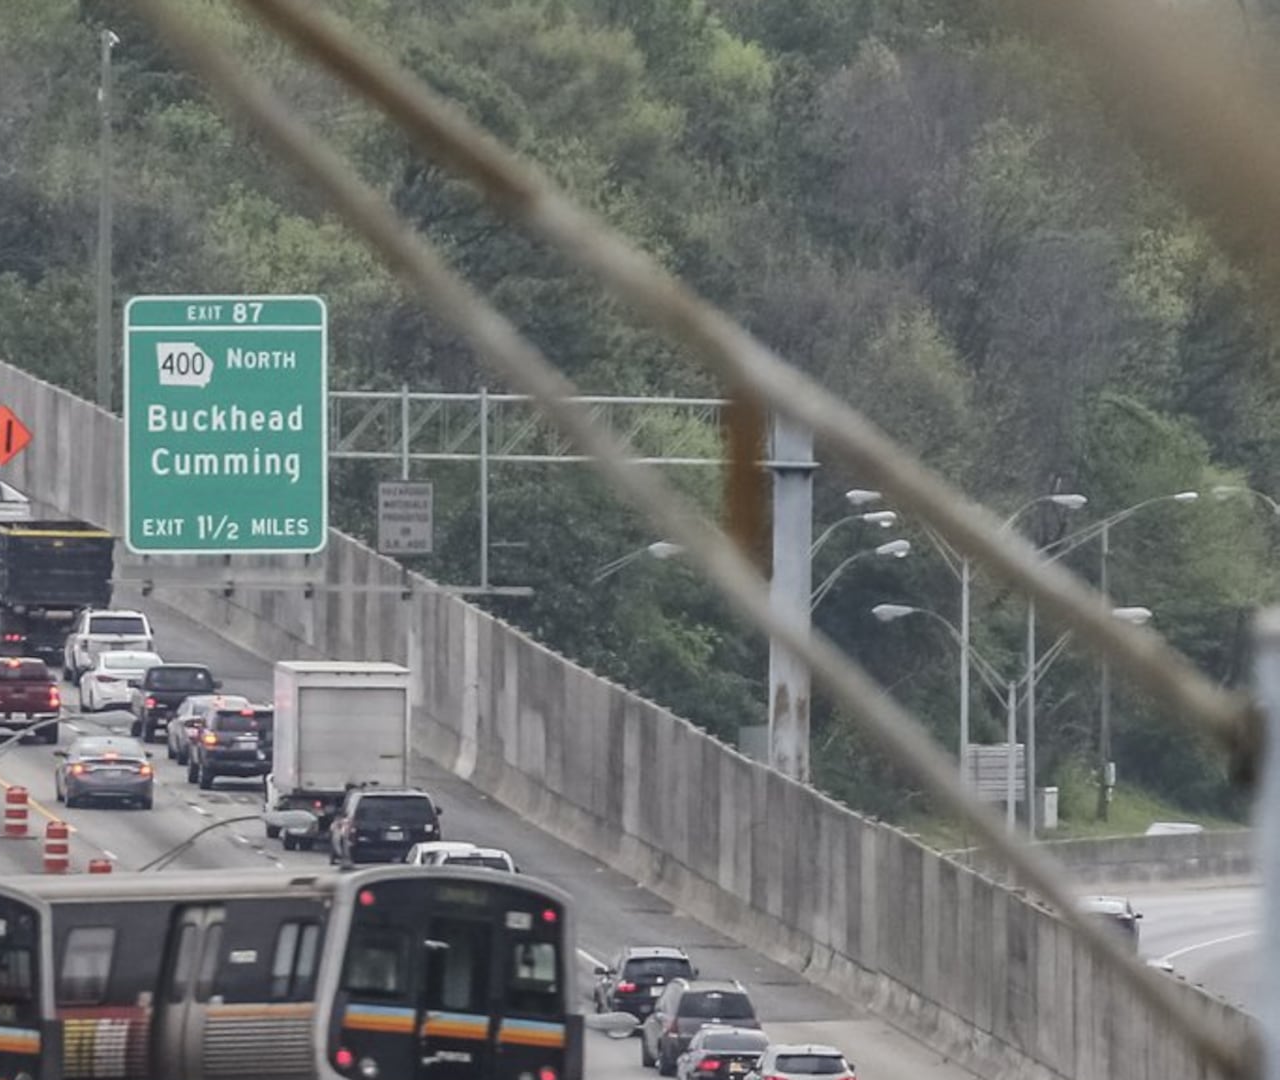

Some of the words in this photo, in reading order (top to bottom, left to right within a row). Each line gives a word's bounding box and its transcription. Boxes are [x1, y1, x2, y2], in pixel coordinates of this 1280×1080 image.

[186, 305, 223, 321] EXIT
[232, 302, 264, 324] 87
[160, 351, 205, 377] 400
[226, 347, 297, 370] NORTH
[146, 404, 303, 433] Buckhead
[151, 447, 301, 483] Cumming
[142, 518, 185, 537] EXIT
[251, 518, 310, 536] MILES
